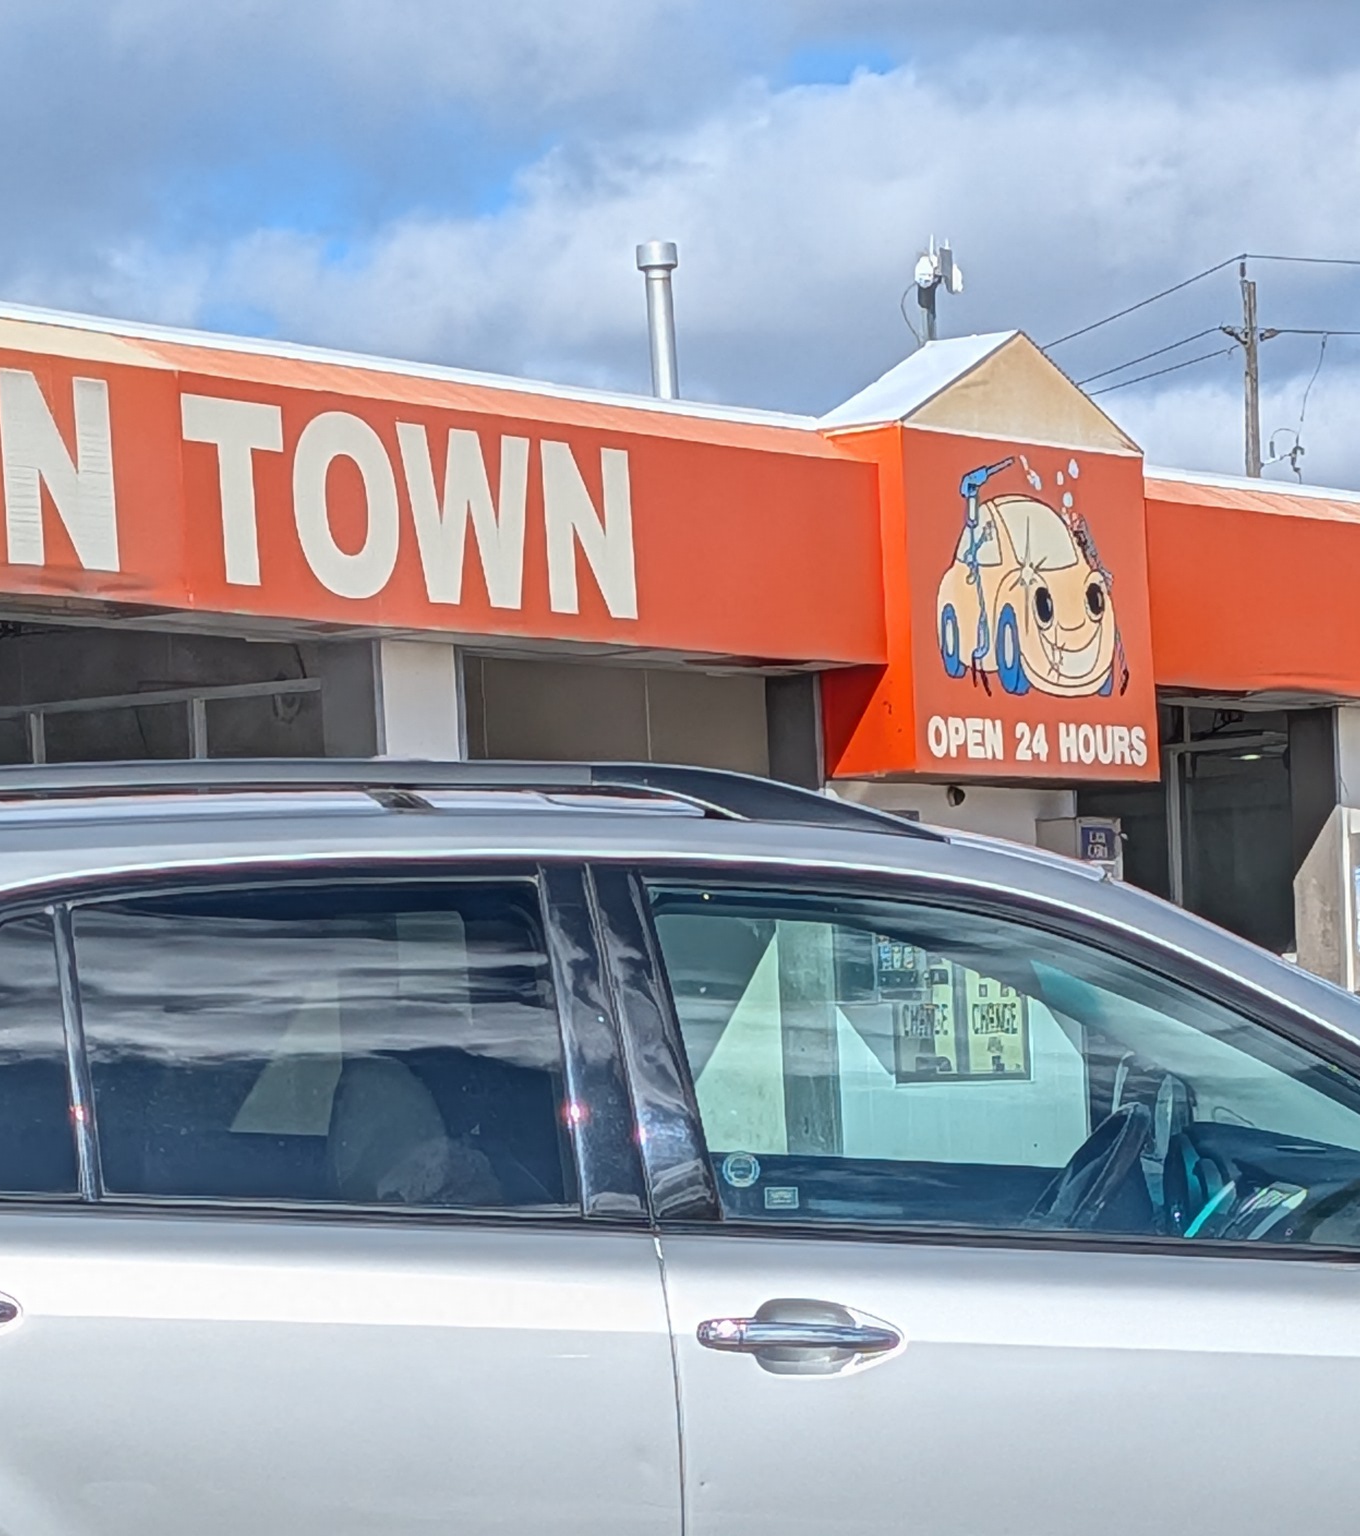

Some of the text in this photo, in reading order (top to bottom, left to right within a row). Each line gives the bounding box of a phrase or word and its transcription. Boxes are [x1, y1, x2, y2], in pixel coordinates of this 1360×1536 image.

[181, 393, 638, 620] TOWN
[927, 715, 1148, 766] OPEN 24 HOURS
